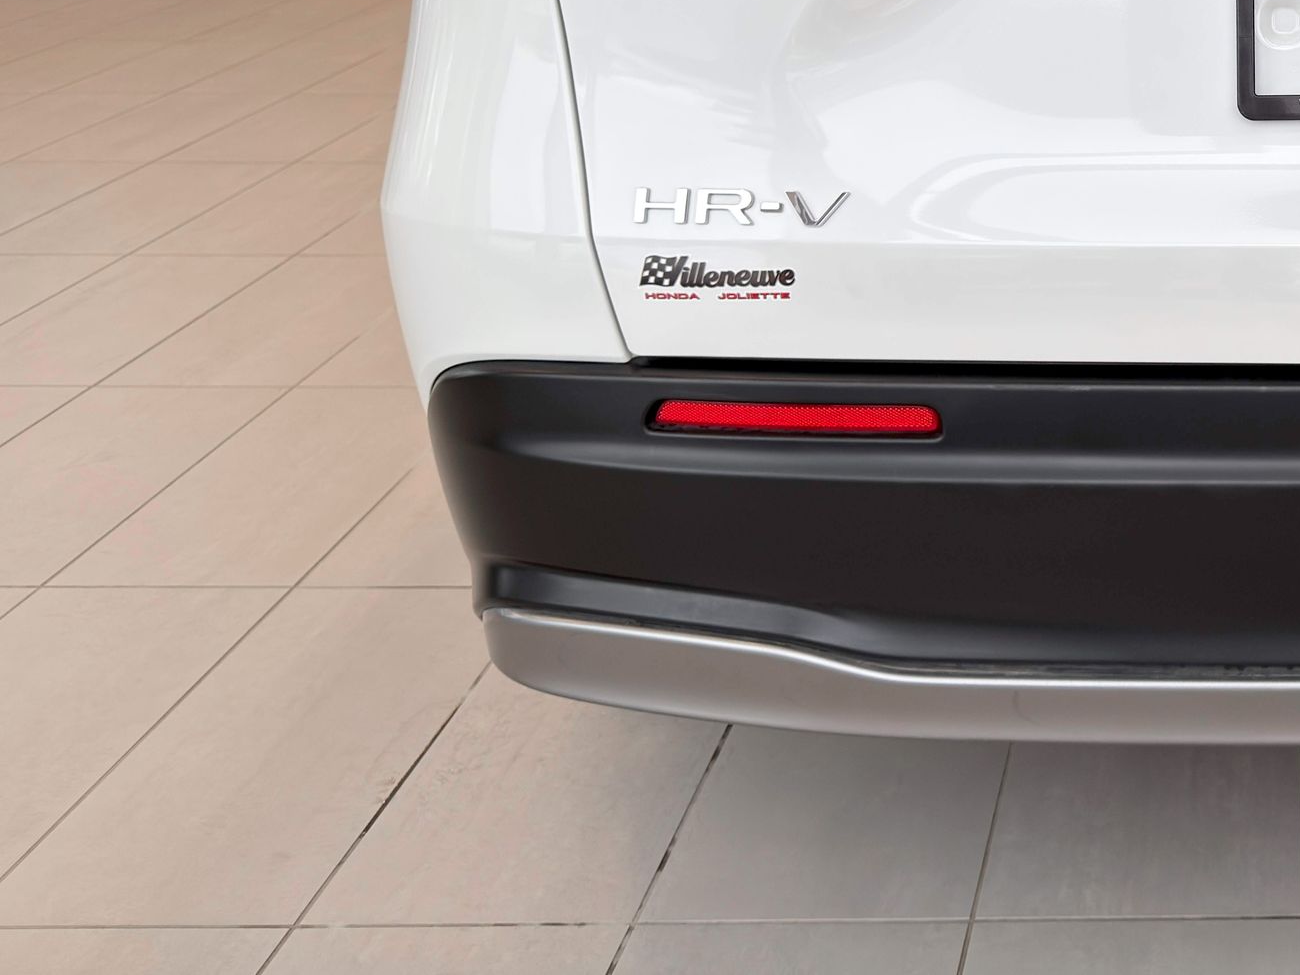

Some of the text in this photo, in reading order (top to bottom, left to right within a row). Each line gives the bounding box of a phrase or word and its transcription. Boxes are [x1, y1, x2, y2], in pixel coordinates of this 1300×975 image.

[632, 187, 852, 227] HR-V
[640, 255, 796, 288] Villeneuve
[645, 292, 791, 300] HONDA JOLIETTE
